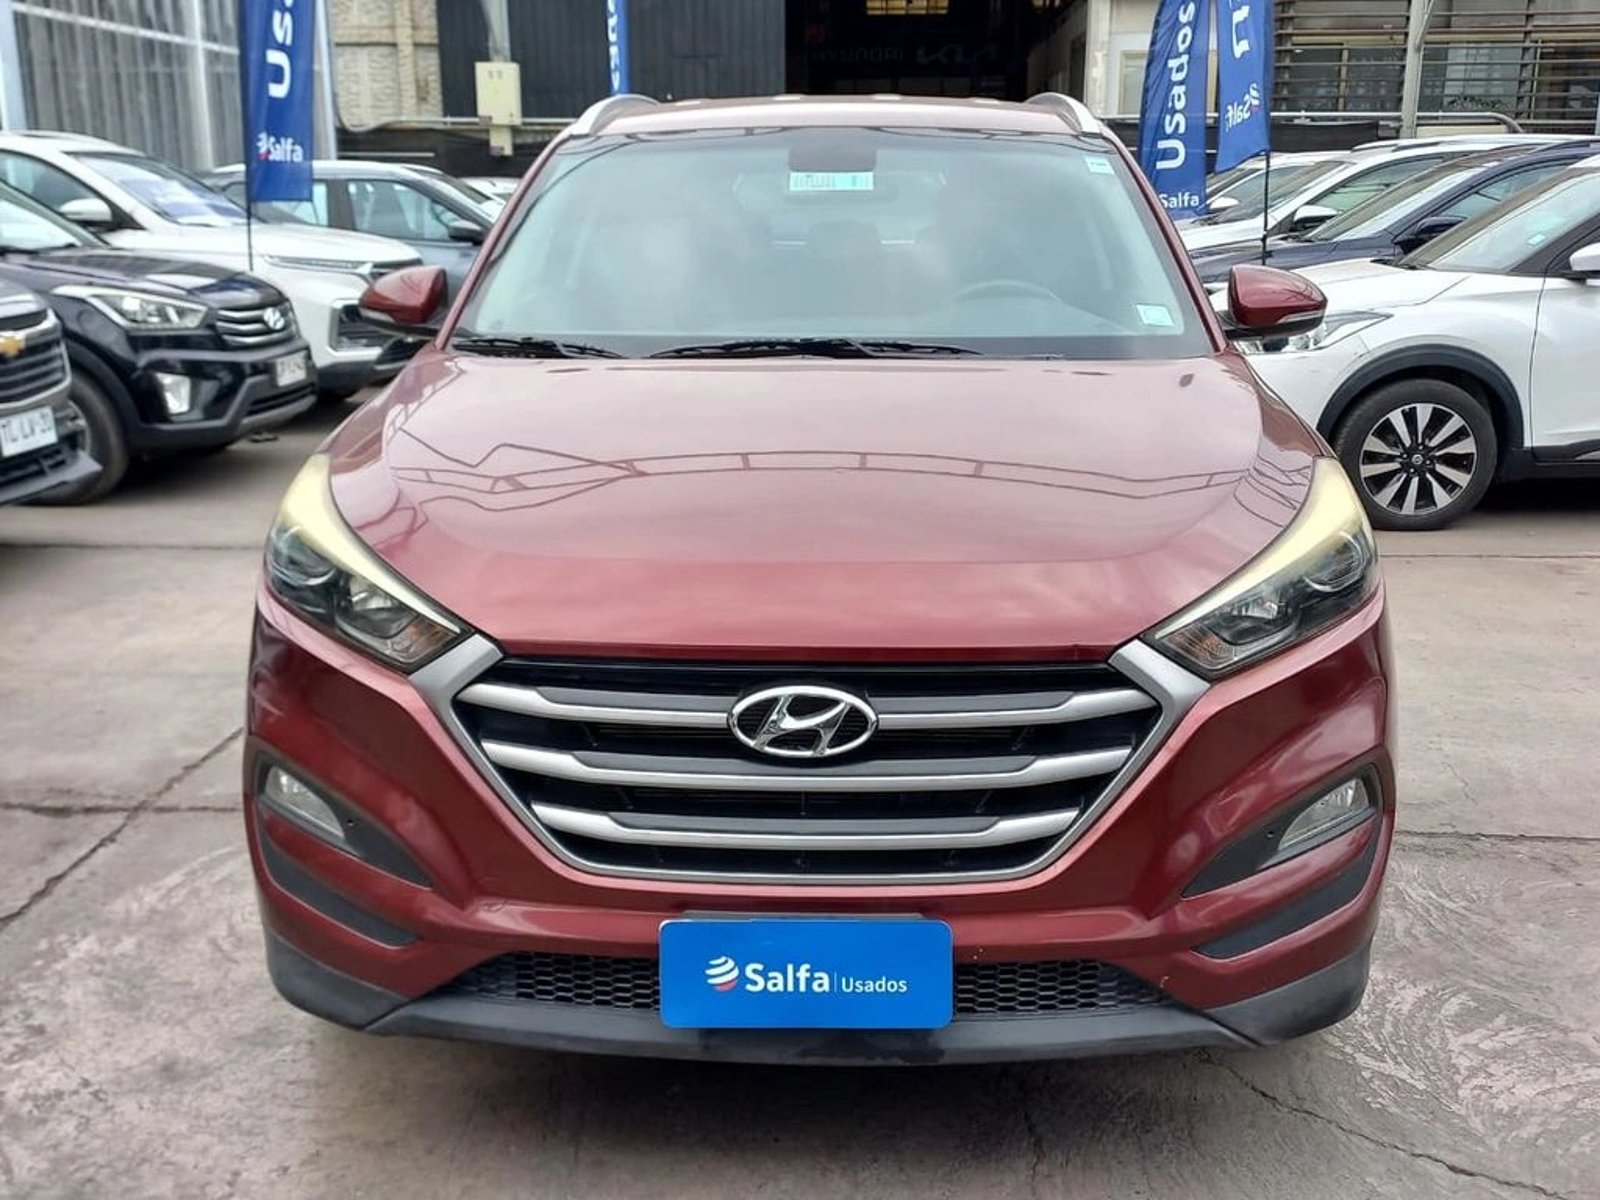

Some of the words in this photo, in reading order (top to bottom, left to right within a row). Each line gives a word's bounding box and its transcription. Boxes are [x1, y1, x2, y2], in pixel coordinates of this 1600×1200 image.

[266, 0, 293, 98] Us
[1156, 1, 1196, 170] Usados
[269, 136, 303, 162] Salfa
[1159, 191, 1200, 209] Salfa
[745, 963, 830, 993] Salfa
[841, 976, 908, 993] Usados
